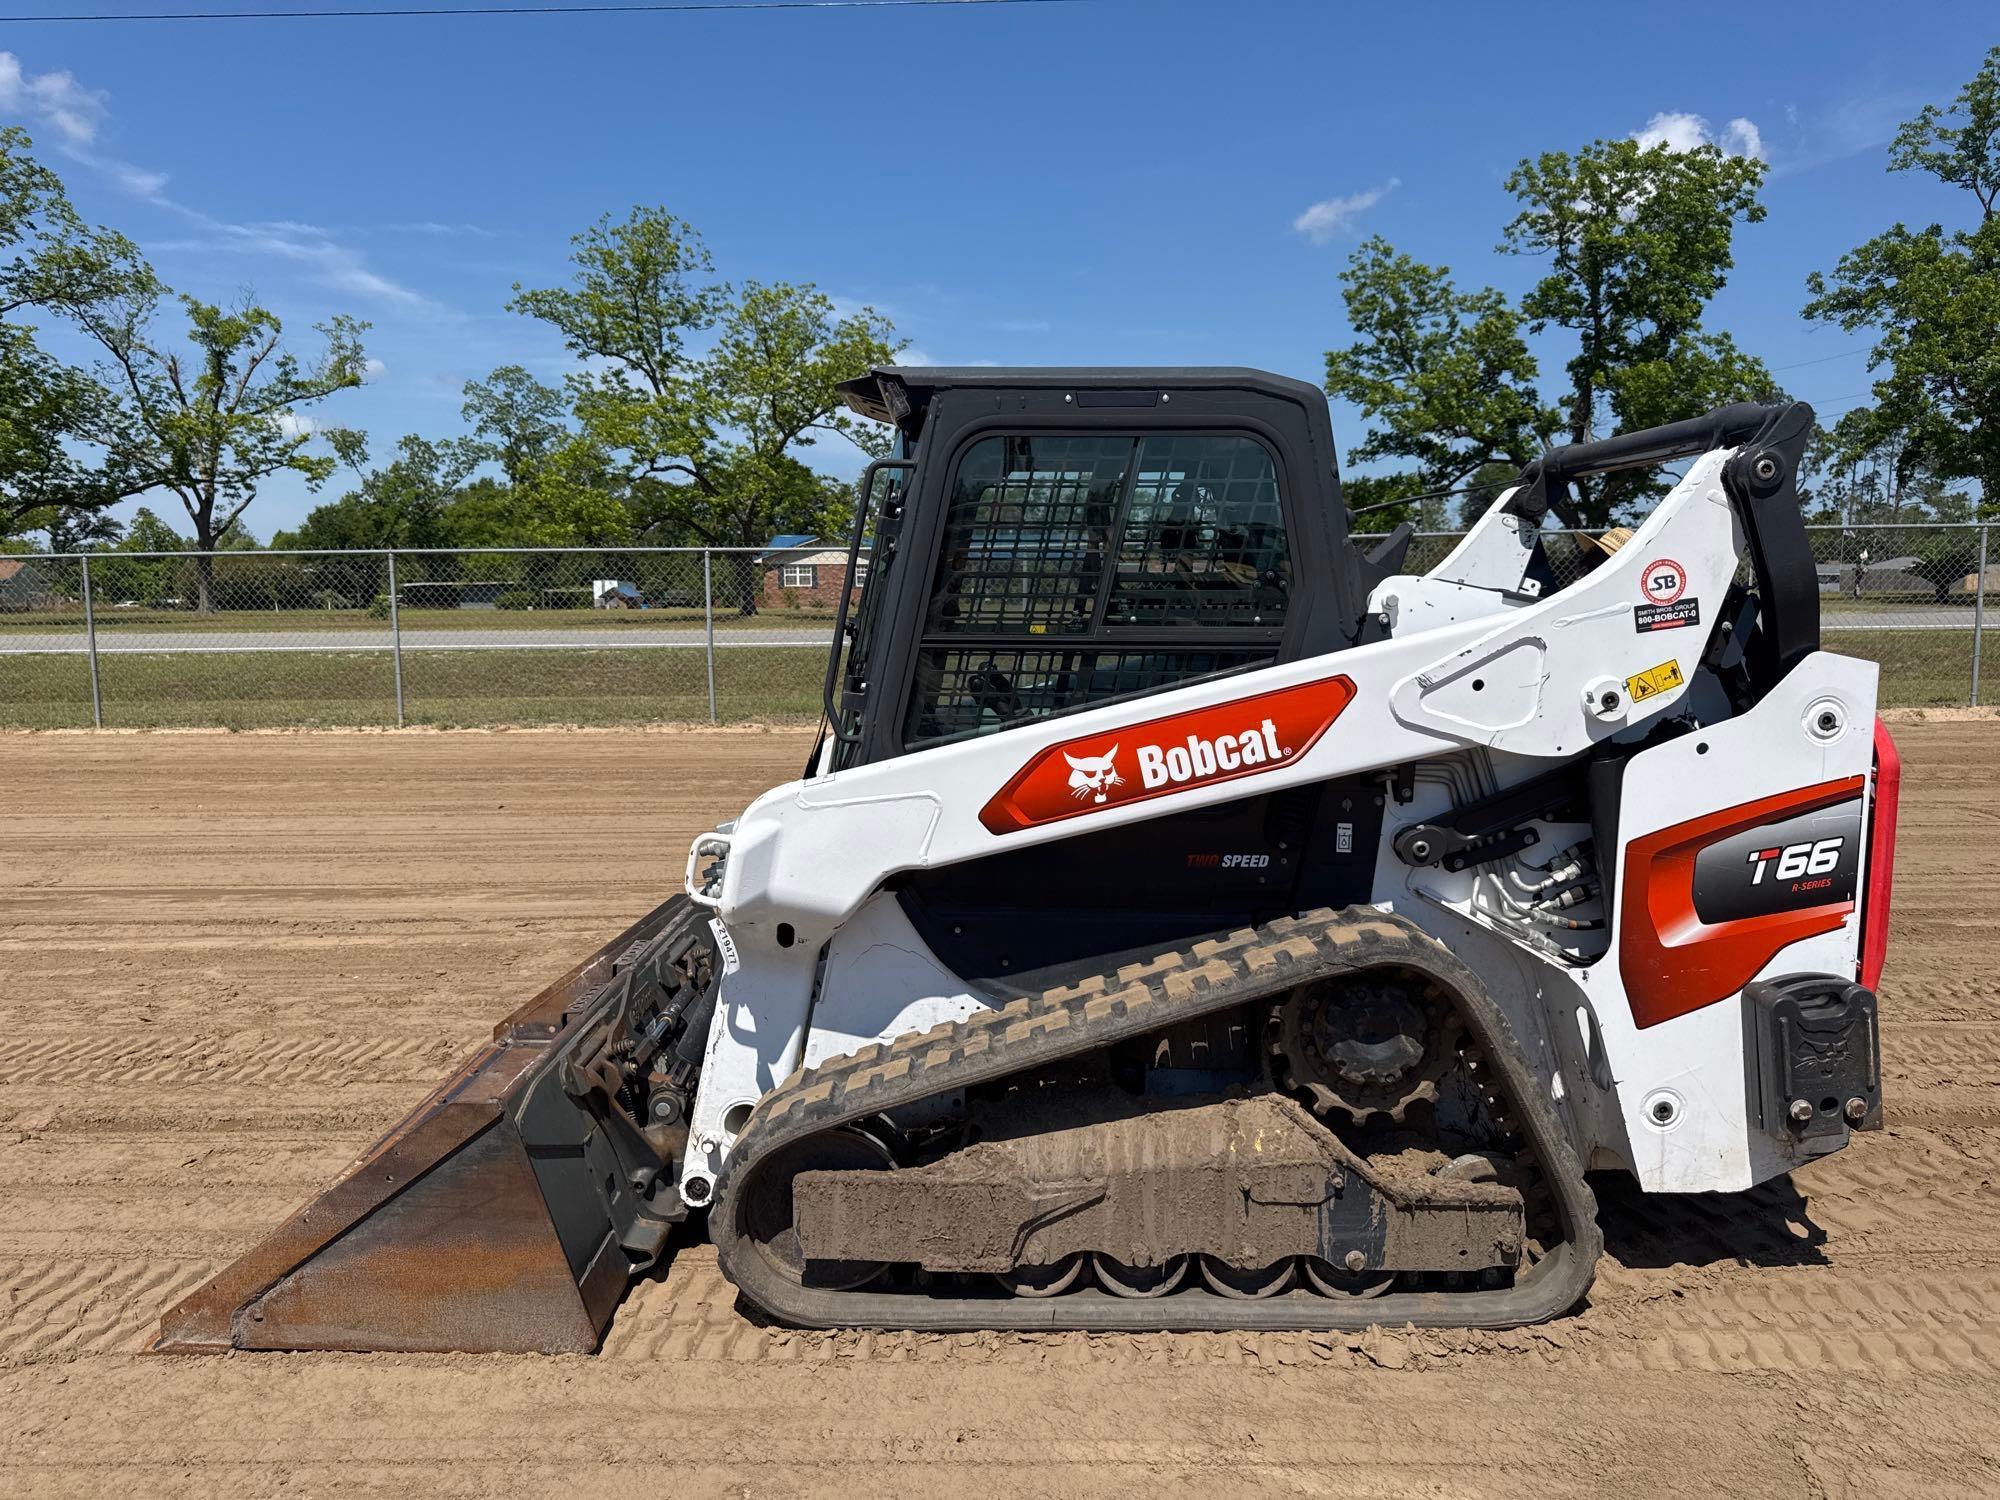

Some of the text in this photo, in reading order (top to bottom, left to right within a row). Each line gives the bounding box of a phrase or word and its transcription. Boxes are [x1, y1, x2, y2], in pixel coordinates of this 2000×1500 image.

[1649, 575, 1676, 591] SB
[1638, 608, 1655, 616] SMITH
[1638, 610, 1696, 624] 800-BOBCAT-0
[1136, 718, 1282, 789] Bobcat
[1187, 855, 1269, 867] TWO SPEED
[1748, 837, 1843, 885] T66
[1791, 878, 1832, 892] R-SERIES
[719, 928, 737, 964] 219477
